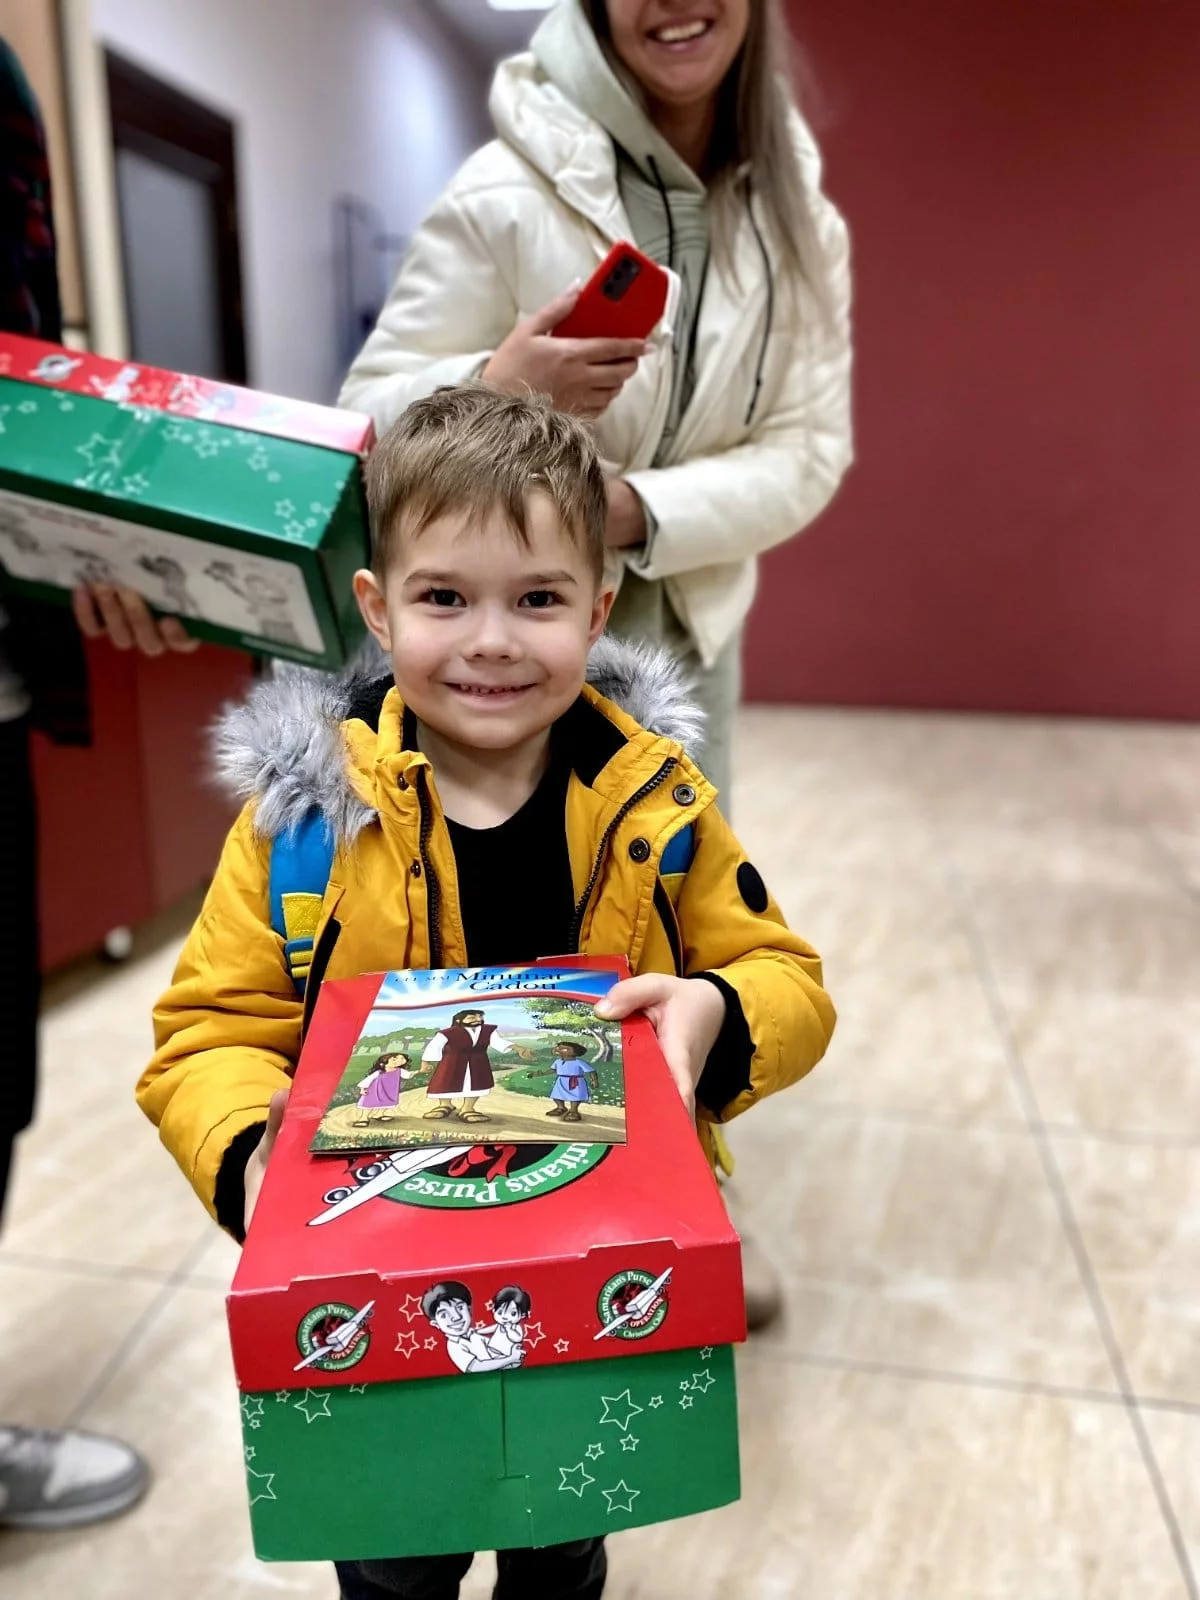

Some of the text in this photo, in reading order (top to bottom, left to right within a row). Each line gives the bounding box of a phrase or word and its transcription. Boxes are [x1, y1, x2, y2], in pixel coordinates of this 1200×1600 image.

[456, 971, 563, 982] Minunat
[469, 980, 557, 991] Cadou
[404, 1142, 594, 1204] ritan's Purse
[626, 1270, 653, 1286] Purse
[327, 1303, 354, 1319] Purse
[629, 1296, 664, 1328] OPERATION
